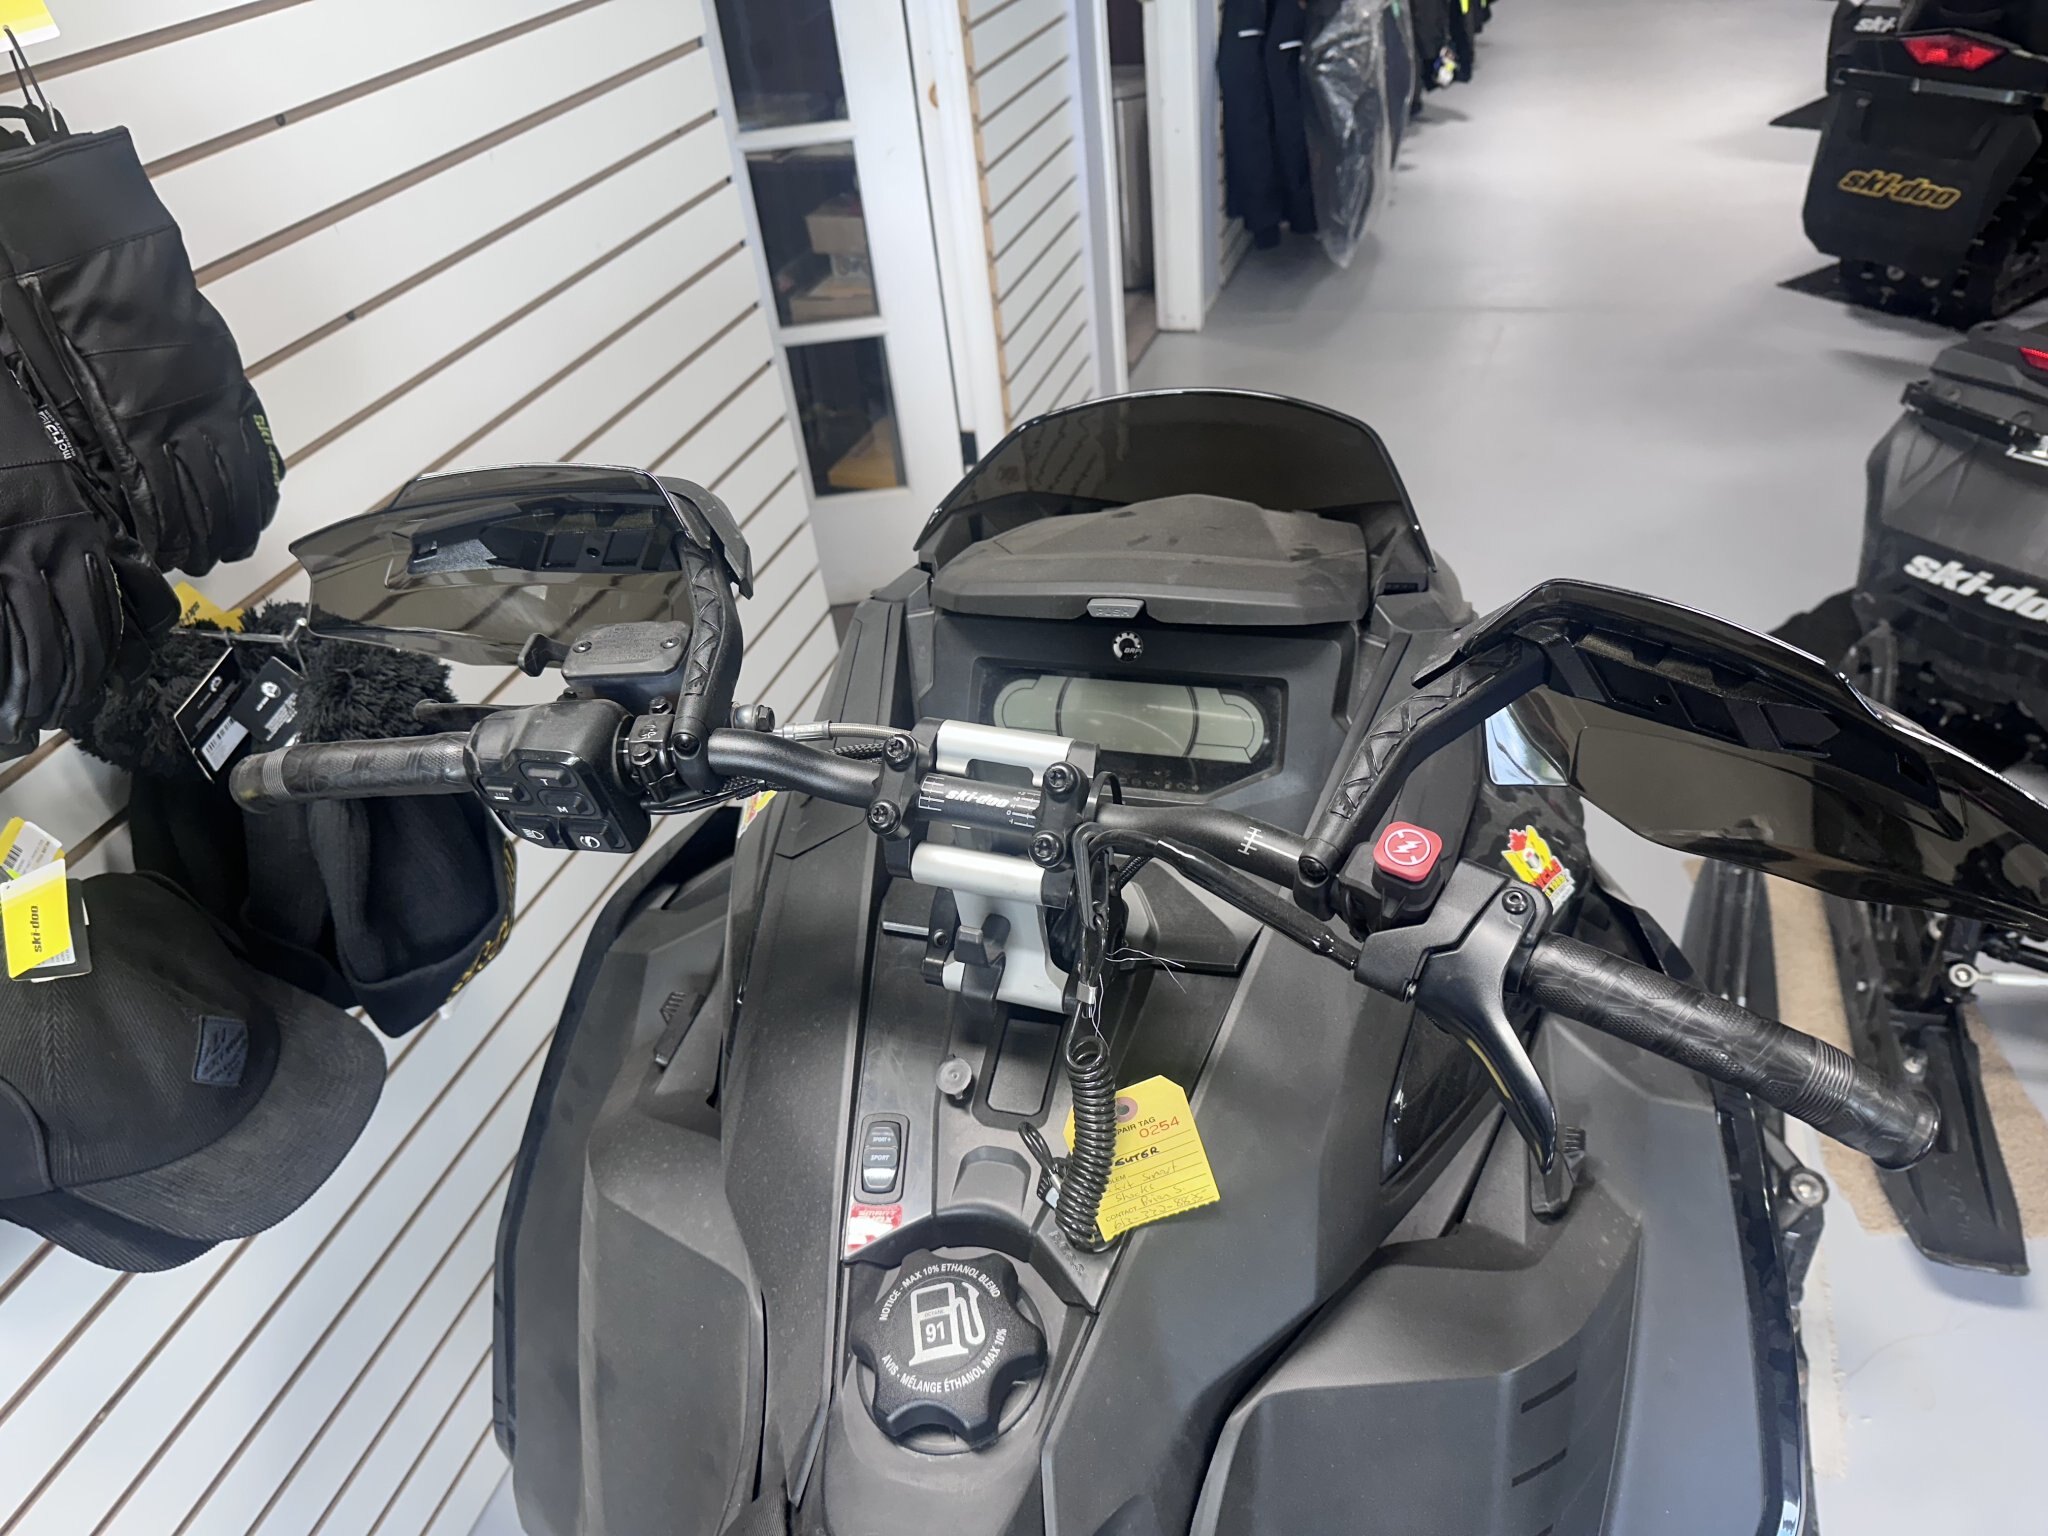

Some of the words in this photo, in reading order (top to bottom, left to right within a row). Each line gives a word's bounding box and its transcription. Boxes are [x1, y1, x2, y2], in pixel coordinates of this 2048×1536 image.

[1853, 15, 1897, 33] ski-
[1838, 168, 1962, 210] ski-doo
[1902, 554, 2048, 624] ski-do
[540, 777, 549, 787] T
[556, 805, 569, 814] M
[945, 789, 1010, 808] ski-doo
[29, 905, 43, 953] ski-doo
[1117, 1123, 1137, 1135] PAIR
[1138, 1116, 1156, 1127] TAG
[1139, 1115, 1180, 1138] 0254
[1105, 1206, 1137, 1222] CONTACT
[879, 1288, 902, 1321] NOTICE
[902, 1271, 923, 1288] MAX
[923, 1264, 940, 1276] 10%
[941, 1263, 980, 1279] ETHANOL
[977, 1273, 1001, 1298] BLEND
[925, 1320, 945, 1343] 91
[881, 1352, 899, 1376] AVIS
[900, 1372, 942, 1393] MÉLANGE
[944, 1365, 986, 1392] ÉTHANOL
[981, 1347, 1000, 1369] MAX
[995, 1328, 1007, 1347] 10%
